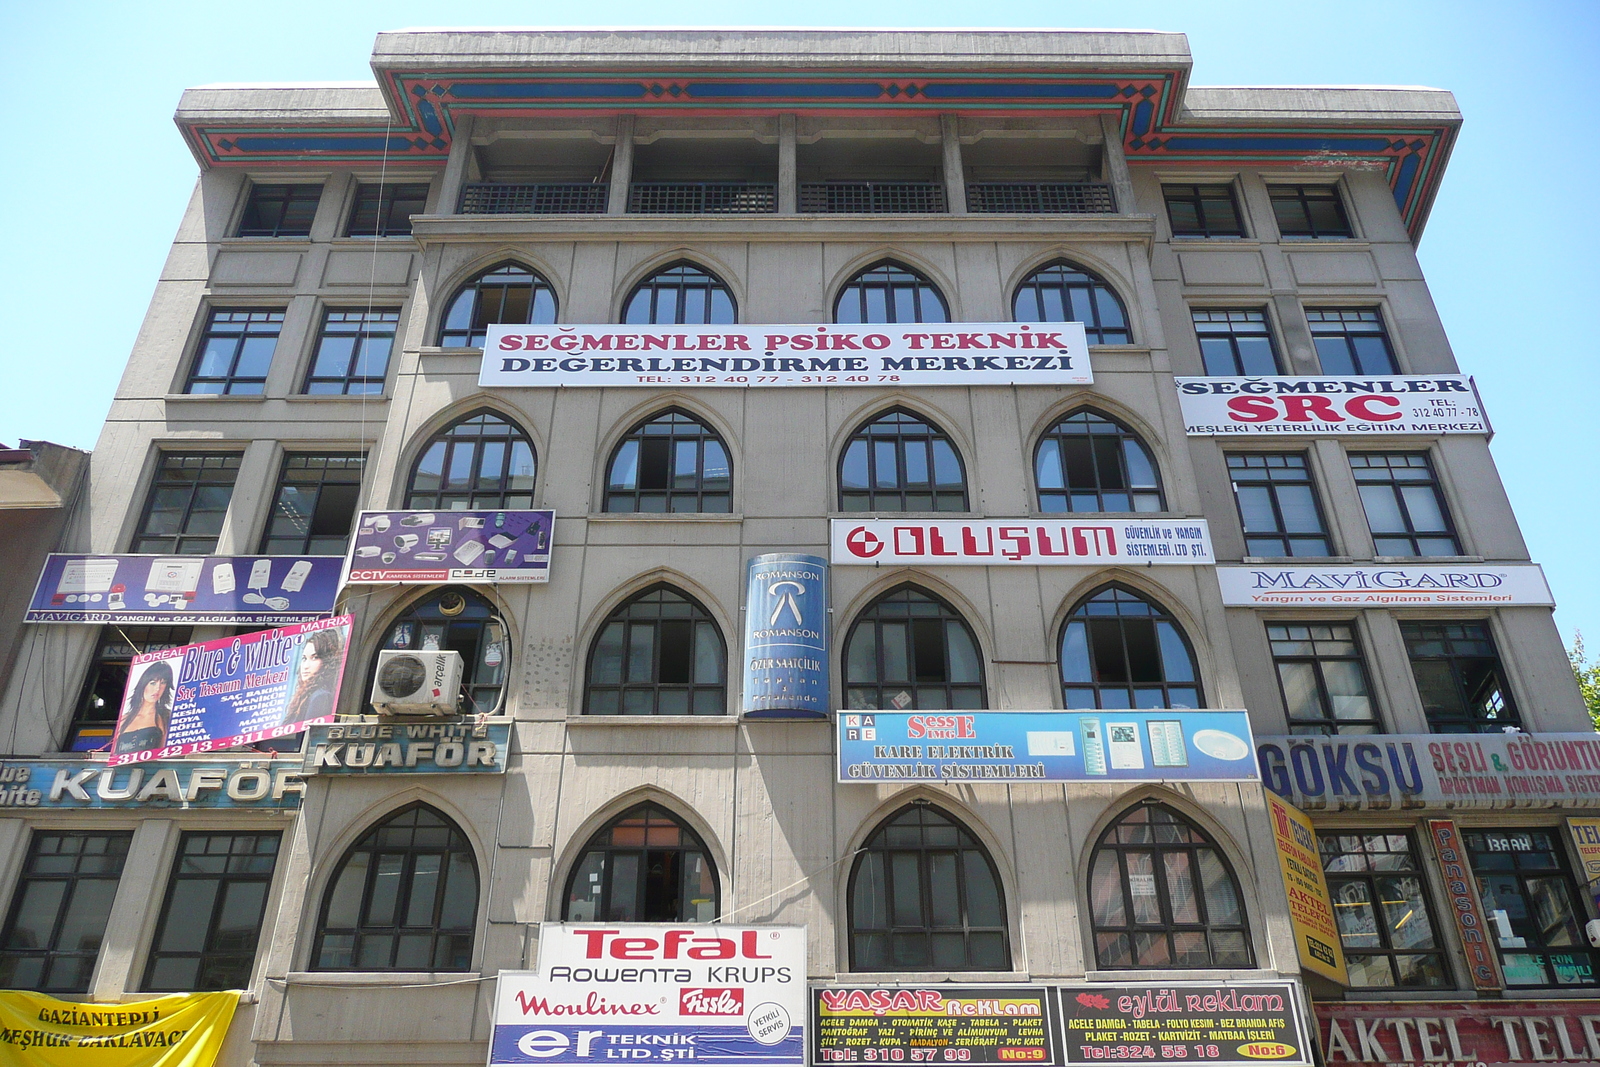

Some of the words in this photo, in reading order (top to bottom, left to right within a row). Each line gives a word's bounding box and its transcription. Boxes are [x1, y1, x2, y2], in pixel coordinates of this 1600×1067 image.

[499, 327, 750, 352] SEĞMENLER
[765, 326, 890, 351] PSİKO
[902, 325, 1064, 350] TEKNİK
[499, 351, 868, 373] DEĞERLENDİRME
[881, 349, 1073, 371] MERKEZİ
[636, 375, 671, 384] TEL:
[680, 375, 720, 384] 312
[725, 375, 751, 384] 40
[756, 375, 781, 384] 77
[801, 374, 839, 383] 312
[844, 374, 870, 383] 40
[876, 374, 900, 383] 78
[1182, 378, 1469, 395] SEĞMENLER
[1227, 395, 1403, 422] SRC
[1428, 399, 1457, 407] TEL:
[1413, 408, 1431, 418] 312
[1432, 407, 1445, 417] 40
[1446, 407, 1458, 417] 77
[1467, 406, 1479, 417] 78
[1185, 423, 1249, 433] MESLEKİ
[1254, 422, 1340, 432] YETERLİLİK
[1347, 421, 1405, 432] EĞİTİM
[1412, 421, 1483, 431] MERKEZİ
[1124, 525, 1161, 540] GÜVENLİK
[1163, 530, 1172, 539] ve
[1175, 527, 1203, 540] YANGIN
[894, 526, 1117, 560] OLUŞUM
[350, 570, 386, 580] CCTV
[755, 570, 820, 581] ROMANSON
[1252, 594, 1304, 604] Yangın
[1331, 594, 1360, 602] Gaz
[1366, 594, 1431, 604] Algılama
[1436, 593, 1513, 602] Sistemleri
[300, 616, 349, 633] MATRIX
[753, 628, 819, 639] ROMANSON
[180, 646, 225, 684] Blue
[226, 638, 242, 676] &
[177, 685, 196, 702] Saç
[243, 666, 289, 690] Merkezi
[220, 693, 243, 702] SAÇ
[246, 684, 287, 698] BAKIMI
[231, 692, 287, 707] MANİKÜR
[172, 707, 206, 718] KESİM
[235, 699, 285, 714] PEDİKÜR
[171, 715, 201, 725] BOYA
[166, 734, 211, 746] KAYNAK
[168, 728, 207, 739] PERMA
[326, 725, 394, 740] BLUE
[407, 724, 488, 739] WHITE
[117, 750, 153, 765] 310
[157, 746, 183, 758] 42
[190, 741, 213, 753] 13
[232, 732, 265, 747] 311
[271, 723, 296, 737] 60
[300, 717, 326, 731] 50
[312, 736, 498, 767] KUAFÖR
[874, 745, 922, 759] KARE
[928, 743, 1015, 759] ELEKTRİK
[847, 763, 937, 779] GÜVENLİK
[941, 763, 1046, 778] SİSTEMLERİ
[1289, 886, 1331, 917] AKTEL
[1437, 828, 1492, 980] Panasonic
[1289, 899, 1334, 928] TELEFON
[573, 930, 772, 960] Tefal
[708, 966, 792, 983] KRUPS
[515, 990, 661, 1016] Moulinex
[682, 988, 743, 1015] Fissler
[820, 989, 945, 1016] YAŞAR
[1117, 989, 1182, 1019] eylül
[38, 1006, 160, 1026] GAZİANTEPLİ
[753, 1007, 780, 1028] YETKİLİ
[820, 1018, 845, 1027] ACELE
[850, 1018, 878, 1027] DAMGA
[892, 1017, 933, 1027] OTOMATİK
[937, 1018, 957, 1028] KAŞE
[970, 1018, 999, 1027] TABELA
[1013, 1018, 1043, 1027] PLAKET
[1068, 1020, 1094, 1029] ACELE
[1096, 1019, 1126, 1029] DAMGA
[1132, 1019, 1160, 1029] TABELA
[1166, 1019, 1189, 1029] FOLYO
[1190, 1018, 1214, 1028] KESİM
[1220, 1019, 1235, 1028] BEZ
[1236, 1018, 1268, 1028] BRANDA
[1269, 1018, 1285, 1029] AFİŞ
[758, 1020, 784, 1039] SERVİS
[821, 1027, 868, 1036] PANTOĞRAF
[878, 1028, 895, 1036] YAZI
[909, 1027, 938, 1037] PİRİNÇ
[942, 1028, 953, 1036] VE
[1018, 1028, 1044, 1036] LEVHA
[1085, 1031, 1118, 1041] PLAKET
[1158, 1030, 1201, 1041] KARTVİZİT
[1209, 1030, 1246, 1040] MATBAA
[1247, 1029, 1275, 1041] İŞLERİ
[518, 1030, 603, 1058] er
[607, 1033, 697, 1045] TEKNİK
[820, 1037, 837, 1047] ŞİLT
[846, 1038, 871, 1046] ROZET
[879, 1038, 901, 1046] KUPA
[909, 1038, 949, 1047] MADALYON
[1006, 1038, 1022, 1046] PVC
[1024, 1038, 1045, 1046] KART
[1326, 1016, 1478, 1062] AKTEL
[820, 1048, 858, 1061] Tel:
[864, 1048, 904, 1061] 310
[910, 1048, 938, 1061] 57
[944, 1048, 971, 1061] 99
[1001, 1050, 1044, 1059] No:9
[1162, 1045, 1188, 1058] 55
[1195, 1045, 1220, 1058] 18
[1248, 1045, 1286, 1056] No:6
